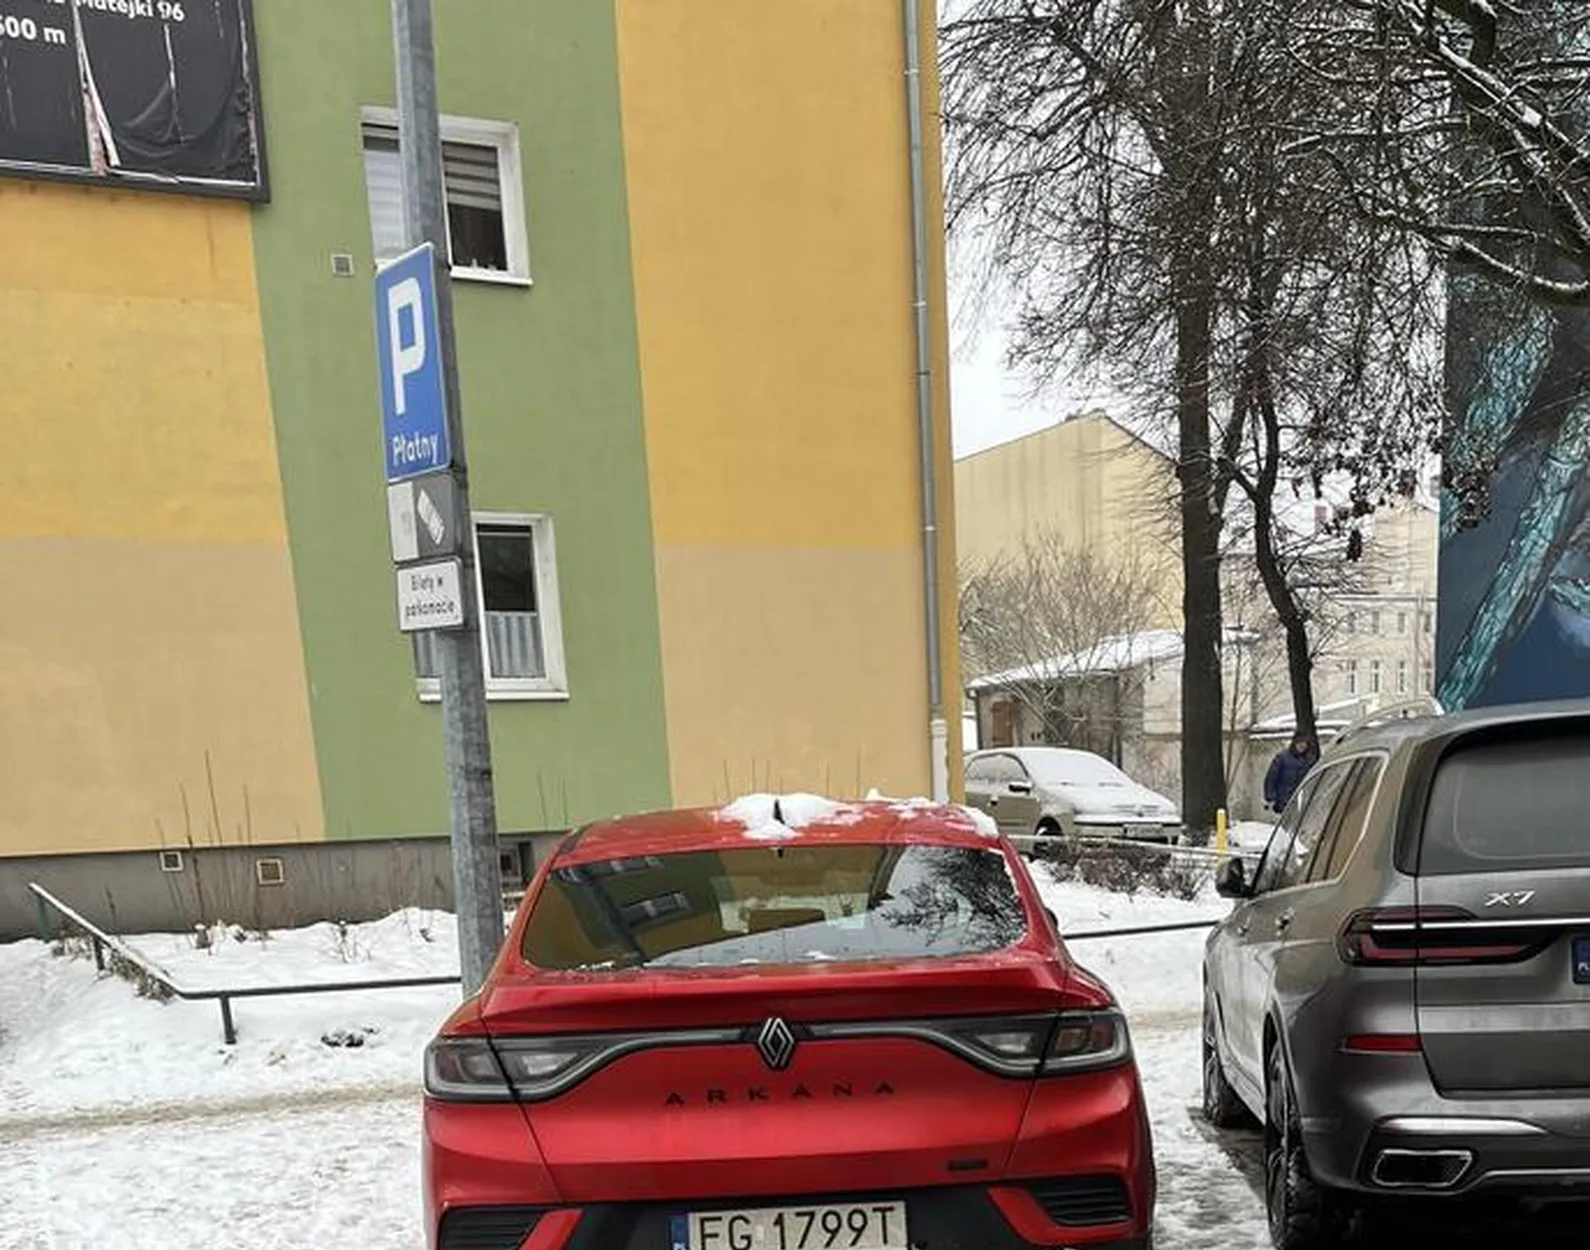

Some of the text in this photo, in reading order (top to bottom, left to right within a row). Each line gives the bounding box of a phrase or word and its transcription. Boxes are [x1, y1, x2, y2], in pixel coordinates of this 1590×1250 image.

[156, 1, 186, 22] 96
[43, 26, 67, 45] m
[388, 277, 426, 416] P
[392, 431, 439, 467] Płatny
[1485, 890, 1536, 907] X7
[665, 1082, 895, 1106] ARKANA
